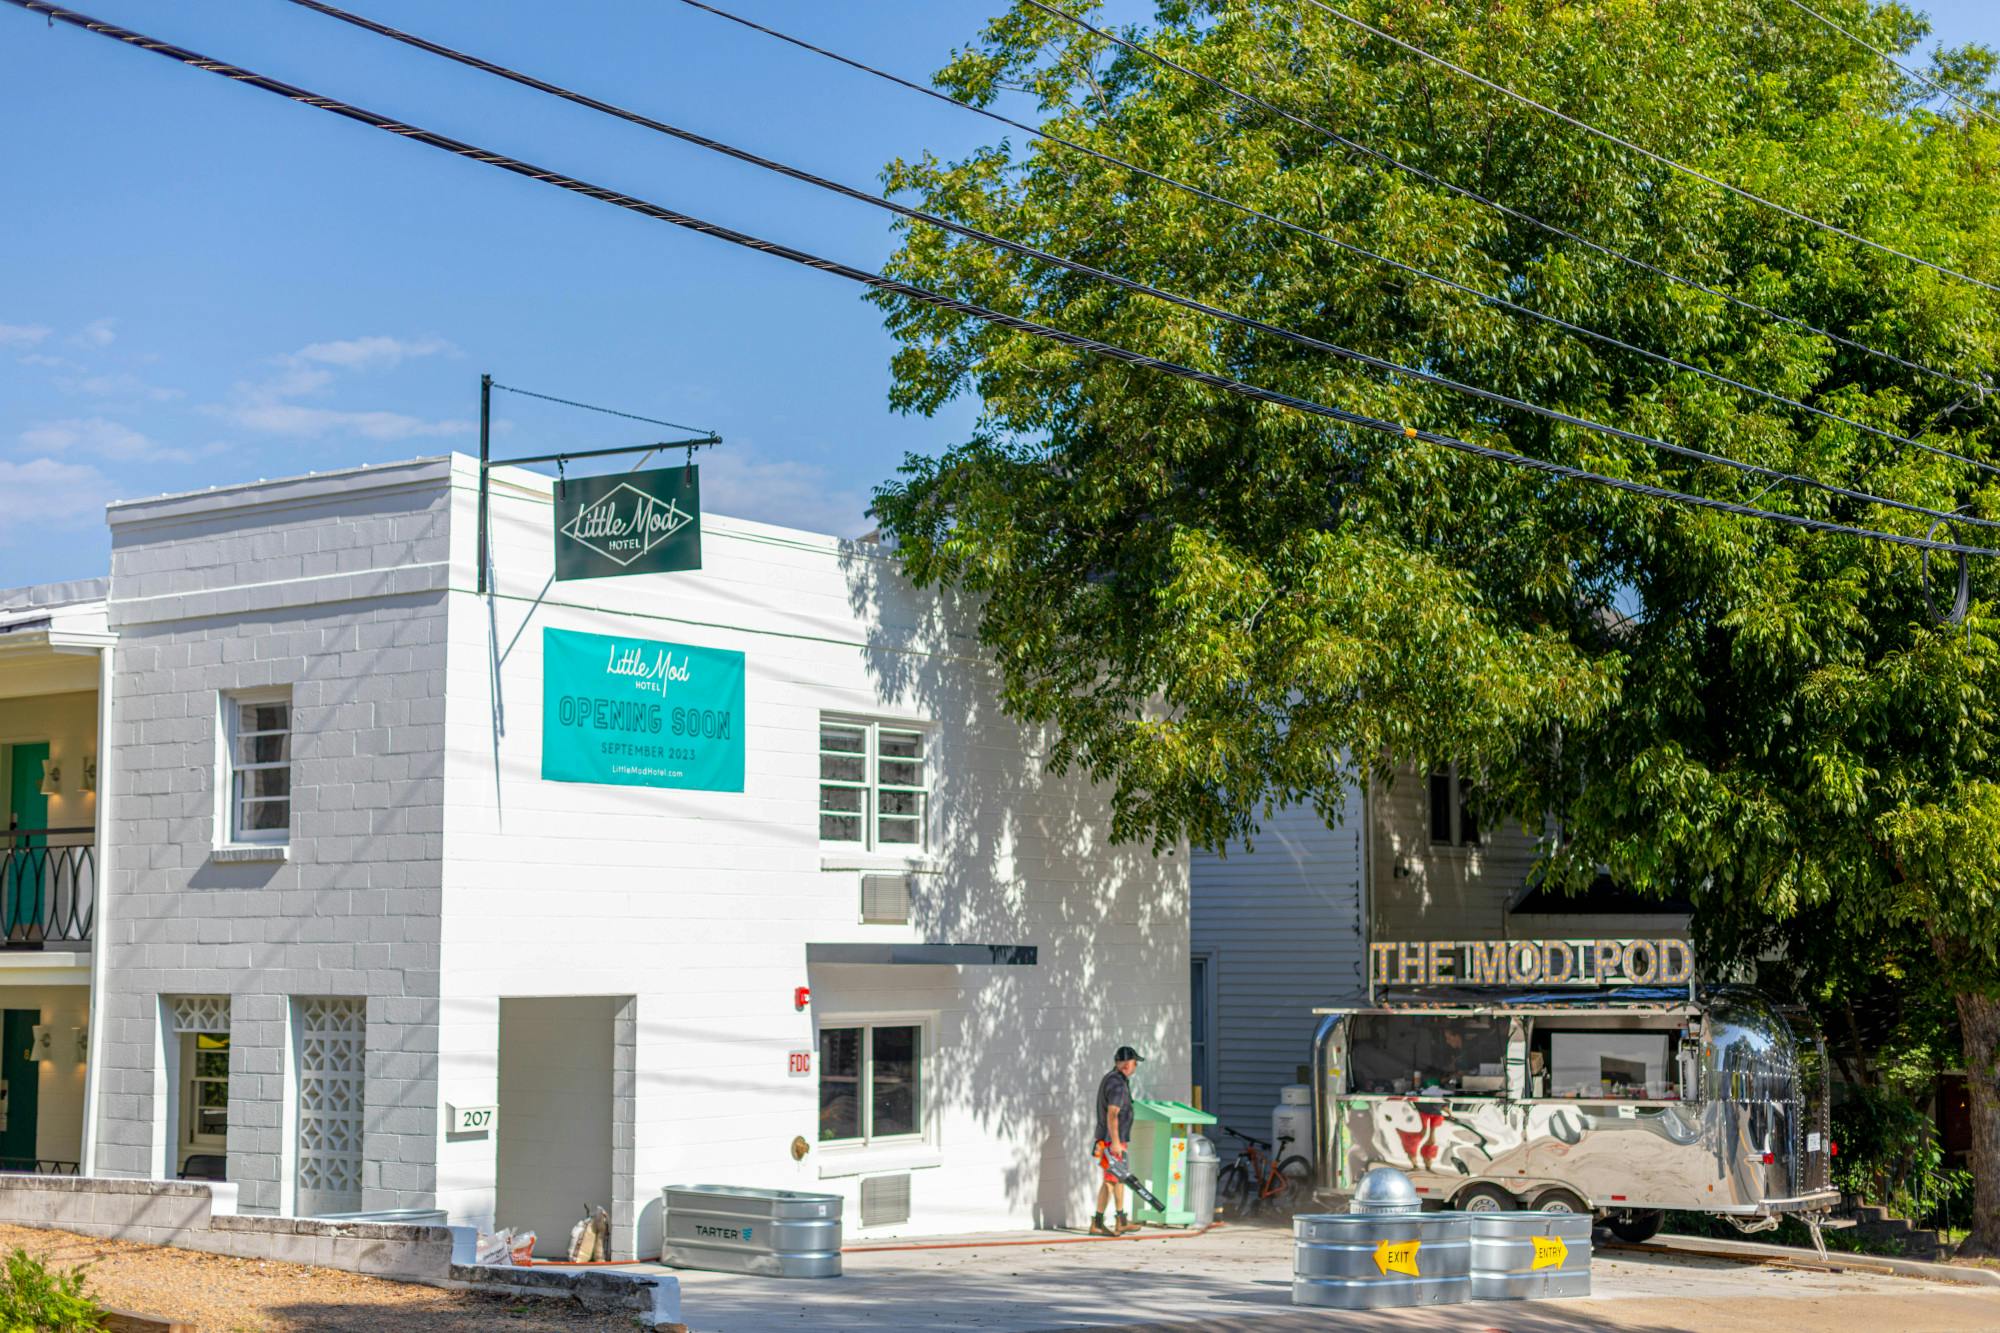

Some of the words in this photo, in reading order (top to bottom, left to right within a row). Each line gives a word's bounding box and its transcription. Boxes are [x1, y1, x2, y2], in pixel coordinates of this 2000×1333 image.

[573, 503, 625, 539] Little
[621, 497, 678, 555] Mod
[608, 538, 641, 550] HOTEL
[607, 644, 650, 676] Little
[646, 649, 690, 698] Mod
[635, 680, 660, 692] HOTEL
[559, 695, 662, 734] OPENING
[671, 707, 731, 740] SOON
[601, 742, 664, 759] SEPTEMBER
[669, 747, 696, 760] 2023
[612, 765, 683, 777] LittleModHotel.com
[1369, 942, 1455, 984] THE
[1473, 939, 1574, 984] MOD
[1595, 938, 1694, 985] POD
[790, 1053, 810, 1072] FDC
[463, 1111, 491, 1127] 207
[696, 1225, 738, 1239] TARTER
[1388, 1251, 1409, 1263] EXIT
[1539, 1246, 1561, 1259] ENTRY
